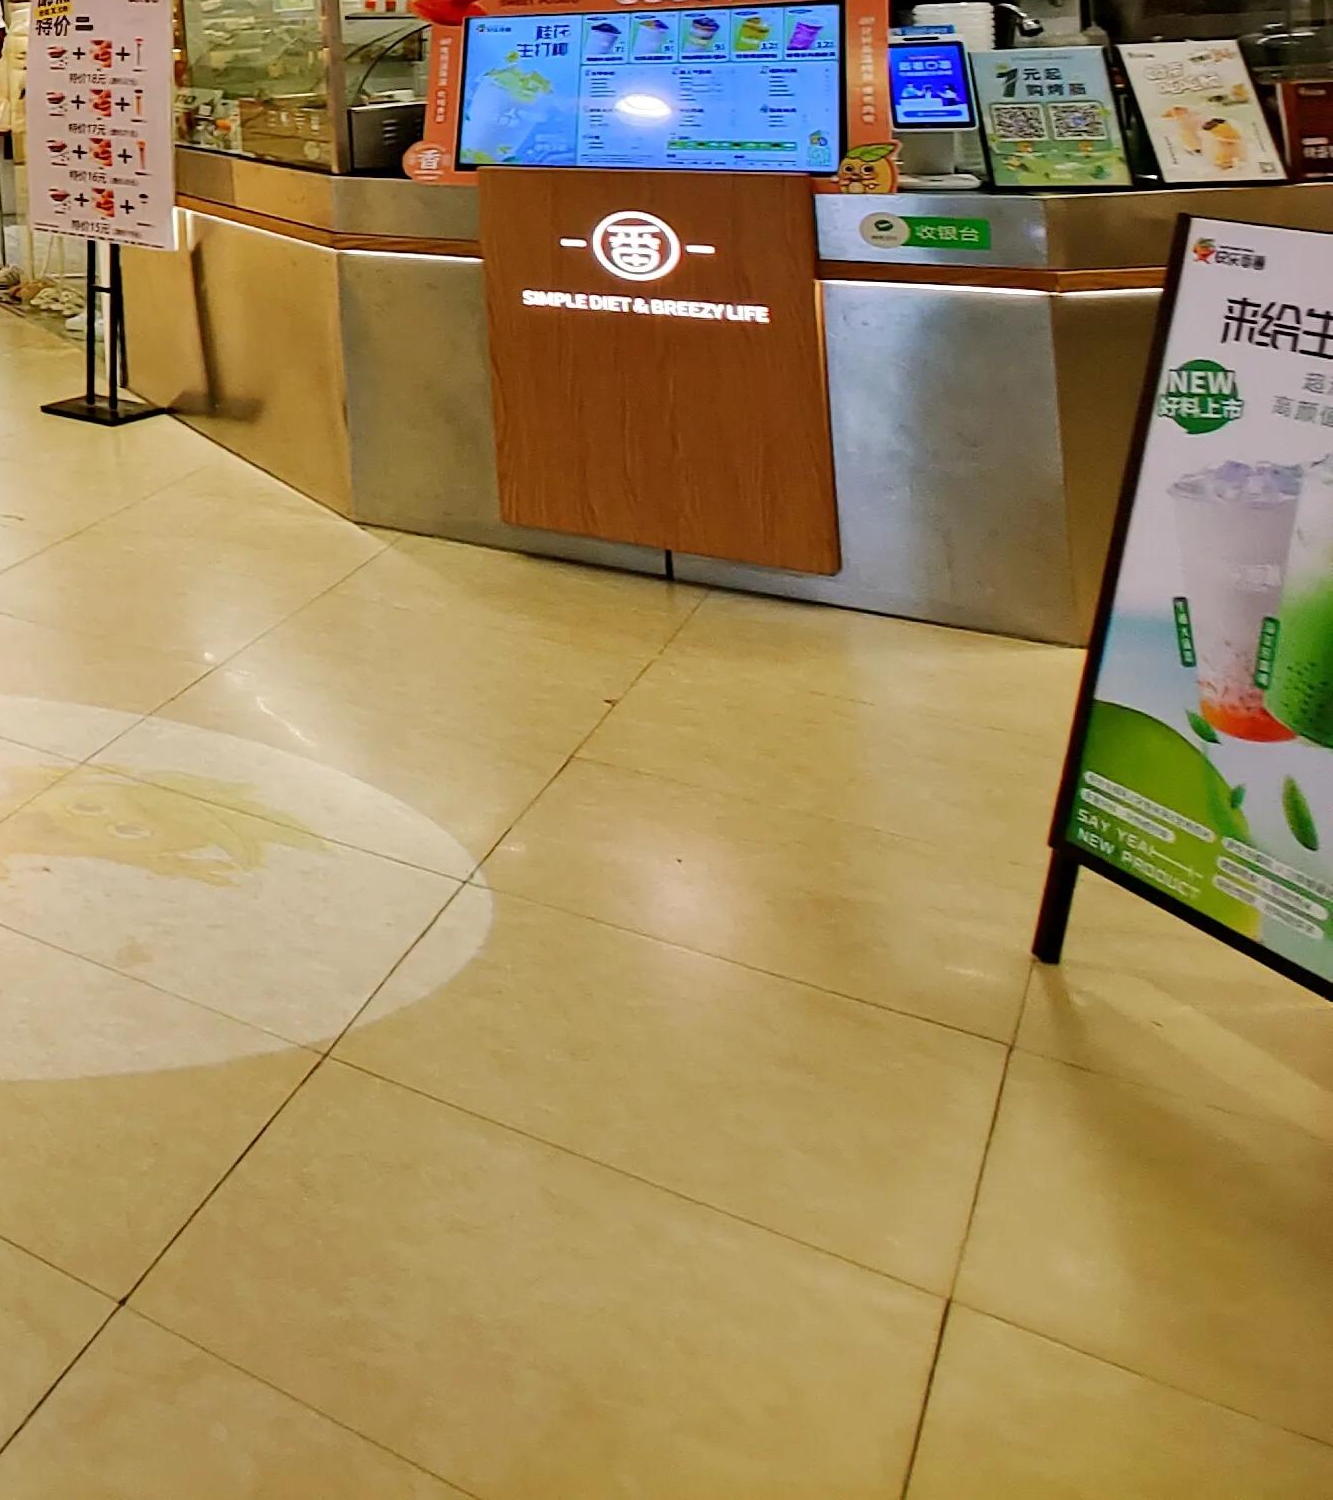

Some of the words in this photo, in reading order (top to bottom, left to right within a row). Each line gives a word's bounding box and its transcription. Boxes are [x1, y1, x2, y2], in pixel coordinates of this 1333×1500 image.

[36, 15, 71, 36] 特价
[915, 225, 980, 242] 收银台
[523, 290, 588, 309] SIMPLE
[590, 294, 631, 313] DIET
[632, 297, 649, 314] &
[651, 300, 725, 321] BREEZY
[726, 305, 770, 323] LIFE
[1168, 370, 1235, 395] NEW
[1077, 809, 1110, 832] SAY
[1077, 827, 1114, 855] NEW
[1121, 850, 1201, 900] PRODUCT
